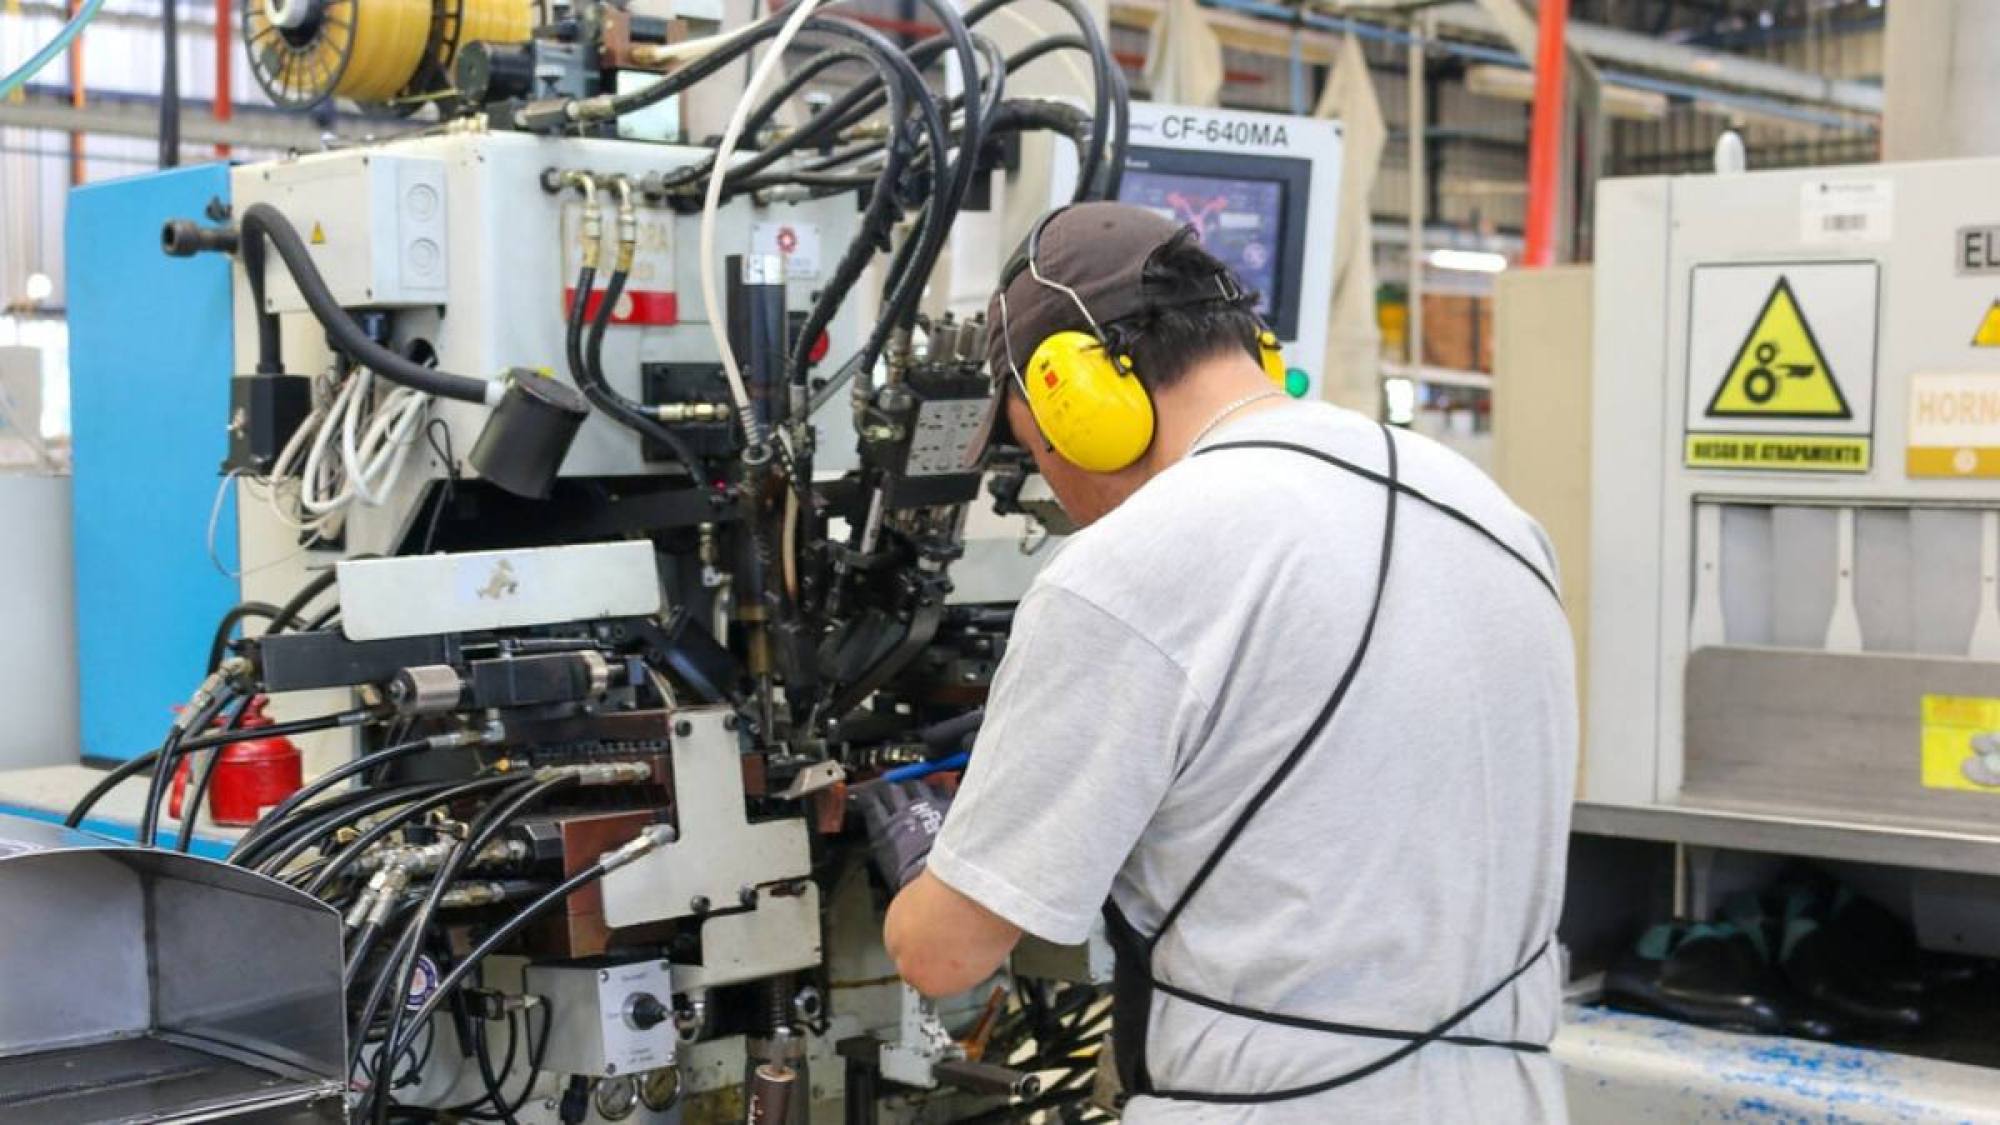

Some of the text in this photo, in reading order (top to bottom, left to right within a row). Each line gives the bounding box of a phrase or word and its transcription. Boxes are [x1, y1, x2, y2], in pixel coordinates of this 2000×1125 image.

[1162, 115, 1288, 146] CF-640MA
[1918, 391, 2000, 425] HORN
[1742, 442, 1756, 460] DE
